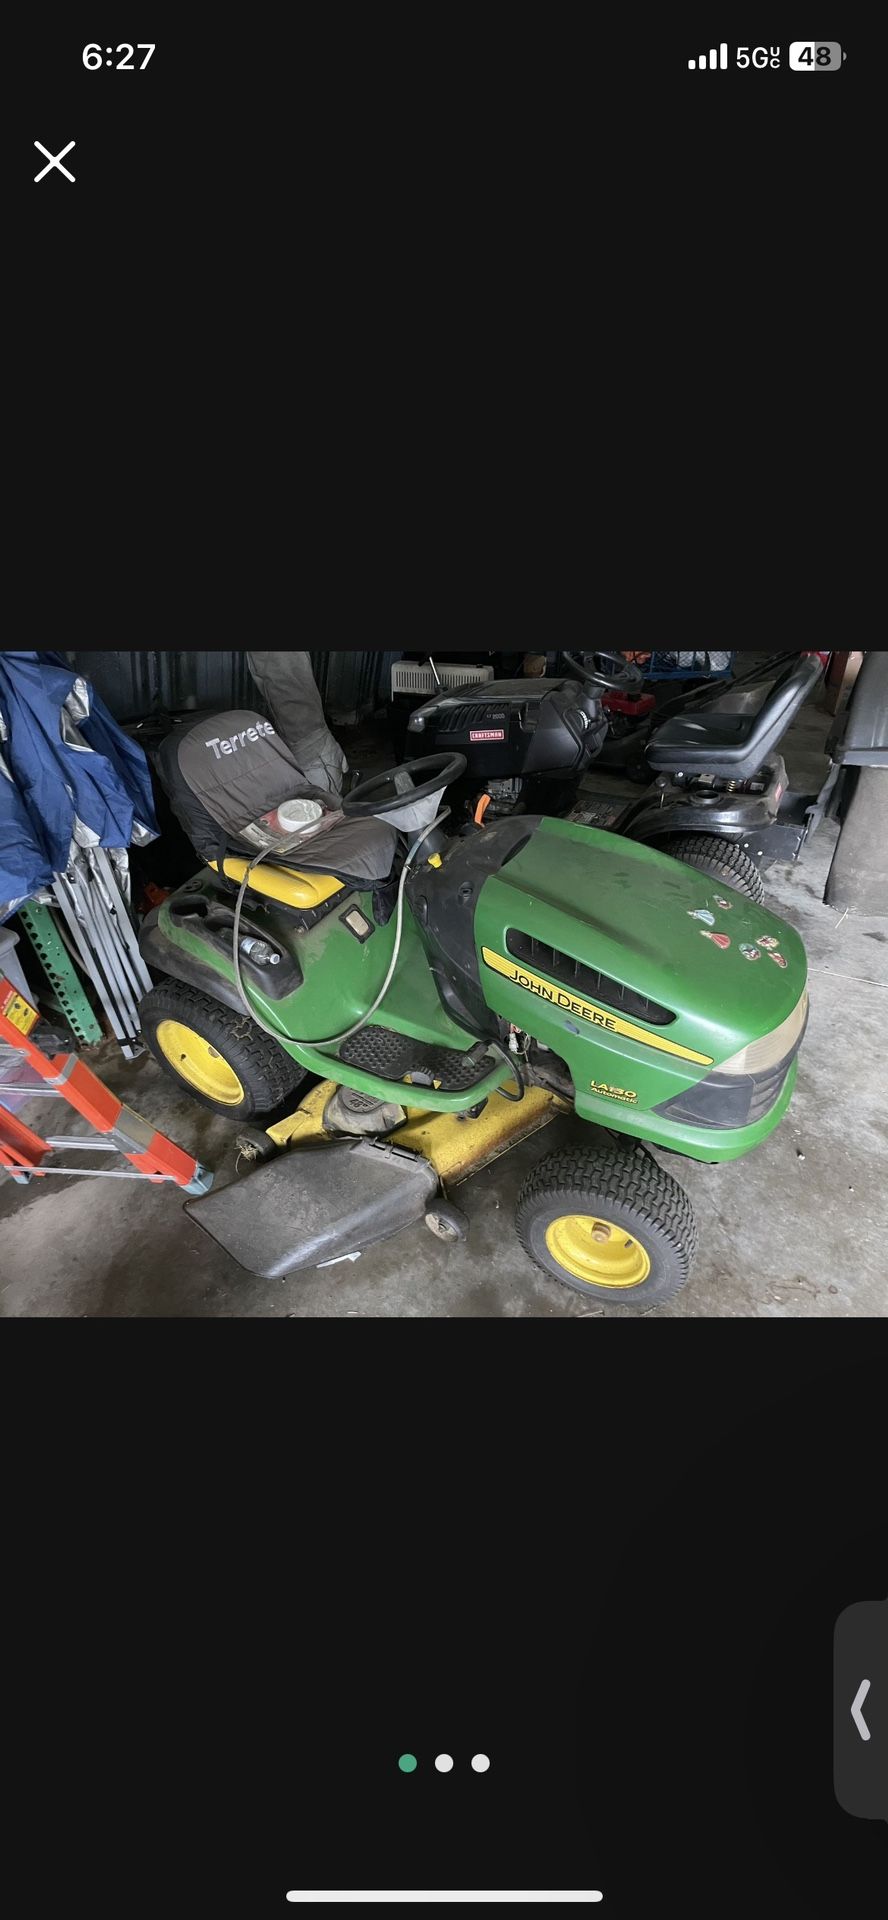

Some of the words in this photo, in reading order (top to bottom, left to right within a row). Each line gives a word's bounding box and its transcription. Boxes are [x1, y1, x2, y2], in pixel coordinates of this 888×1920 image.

[471, 731, 503, 739] CRAFTSMAN
[509, 970, 553, 1001] JOHN
[557, 992, 617, 1030] DEERE
[591, 1087, 638, 1104] Automatic
